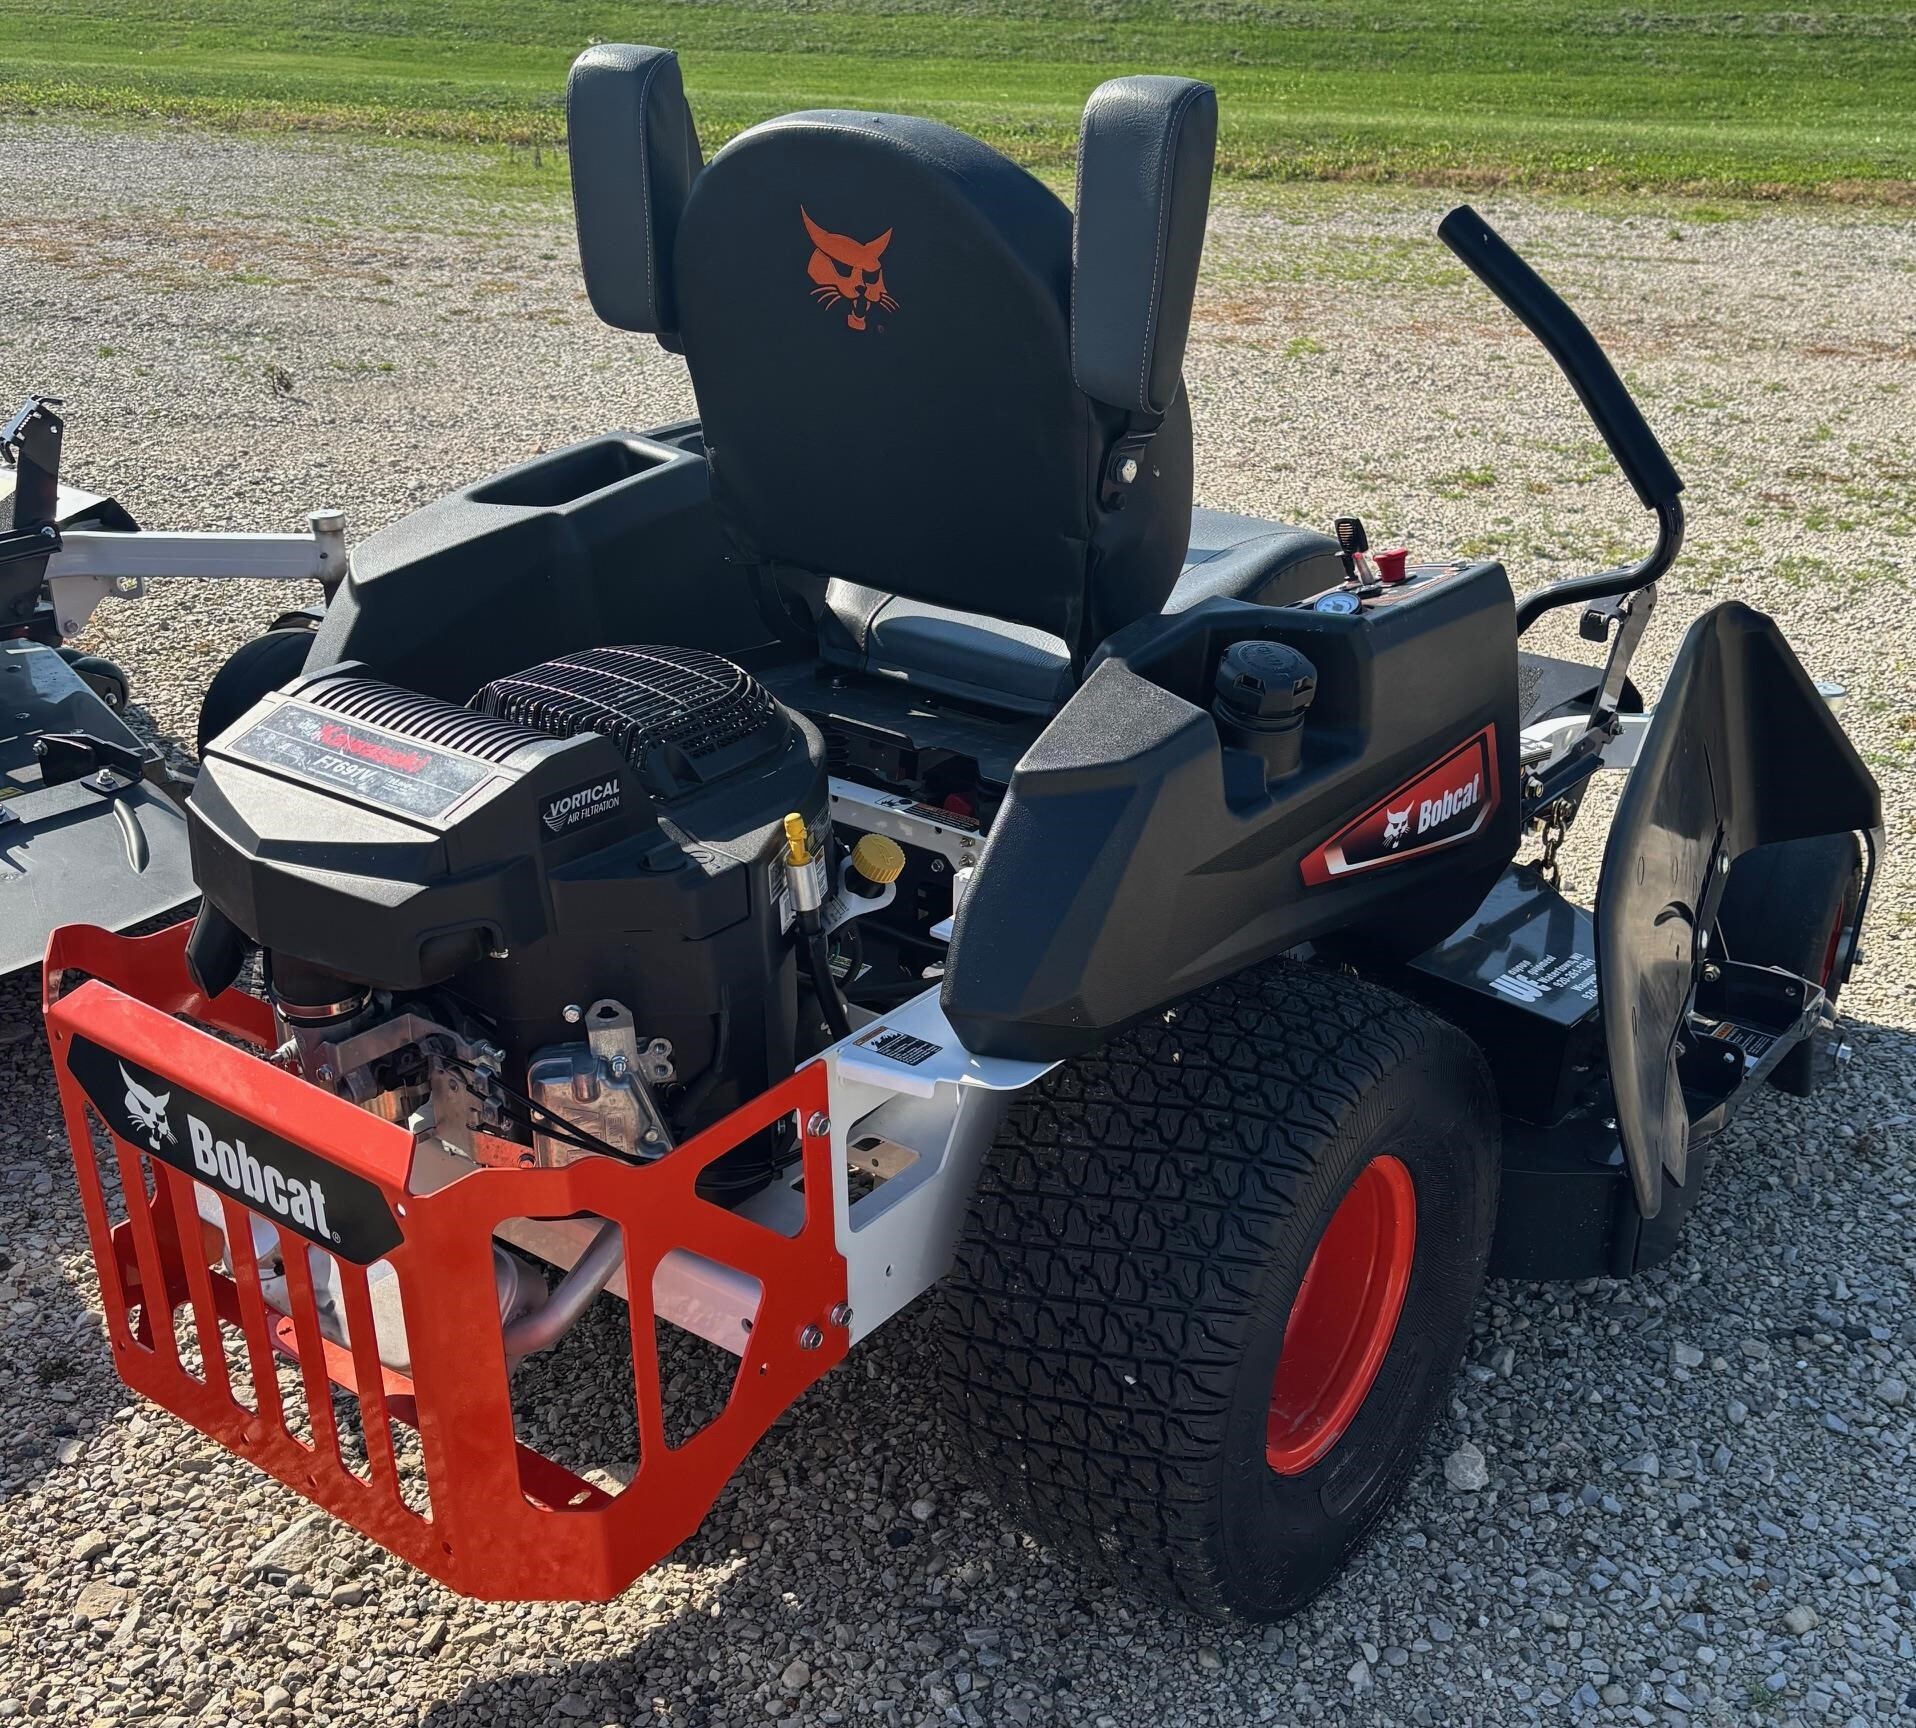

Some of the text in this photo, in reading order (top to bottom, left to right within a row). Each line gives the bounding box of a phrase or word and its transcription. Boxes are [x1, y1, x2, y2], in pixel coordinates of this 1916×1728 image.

[550, 779, 620, 817] VORTICAL
[567, 796, 620, 825] AIR FILTRATION
[1417, 773, 1480, 835] Bobcat
